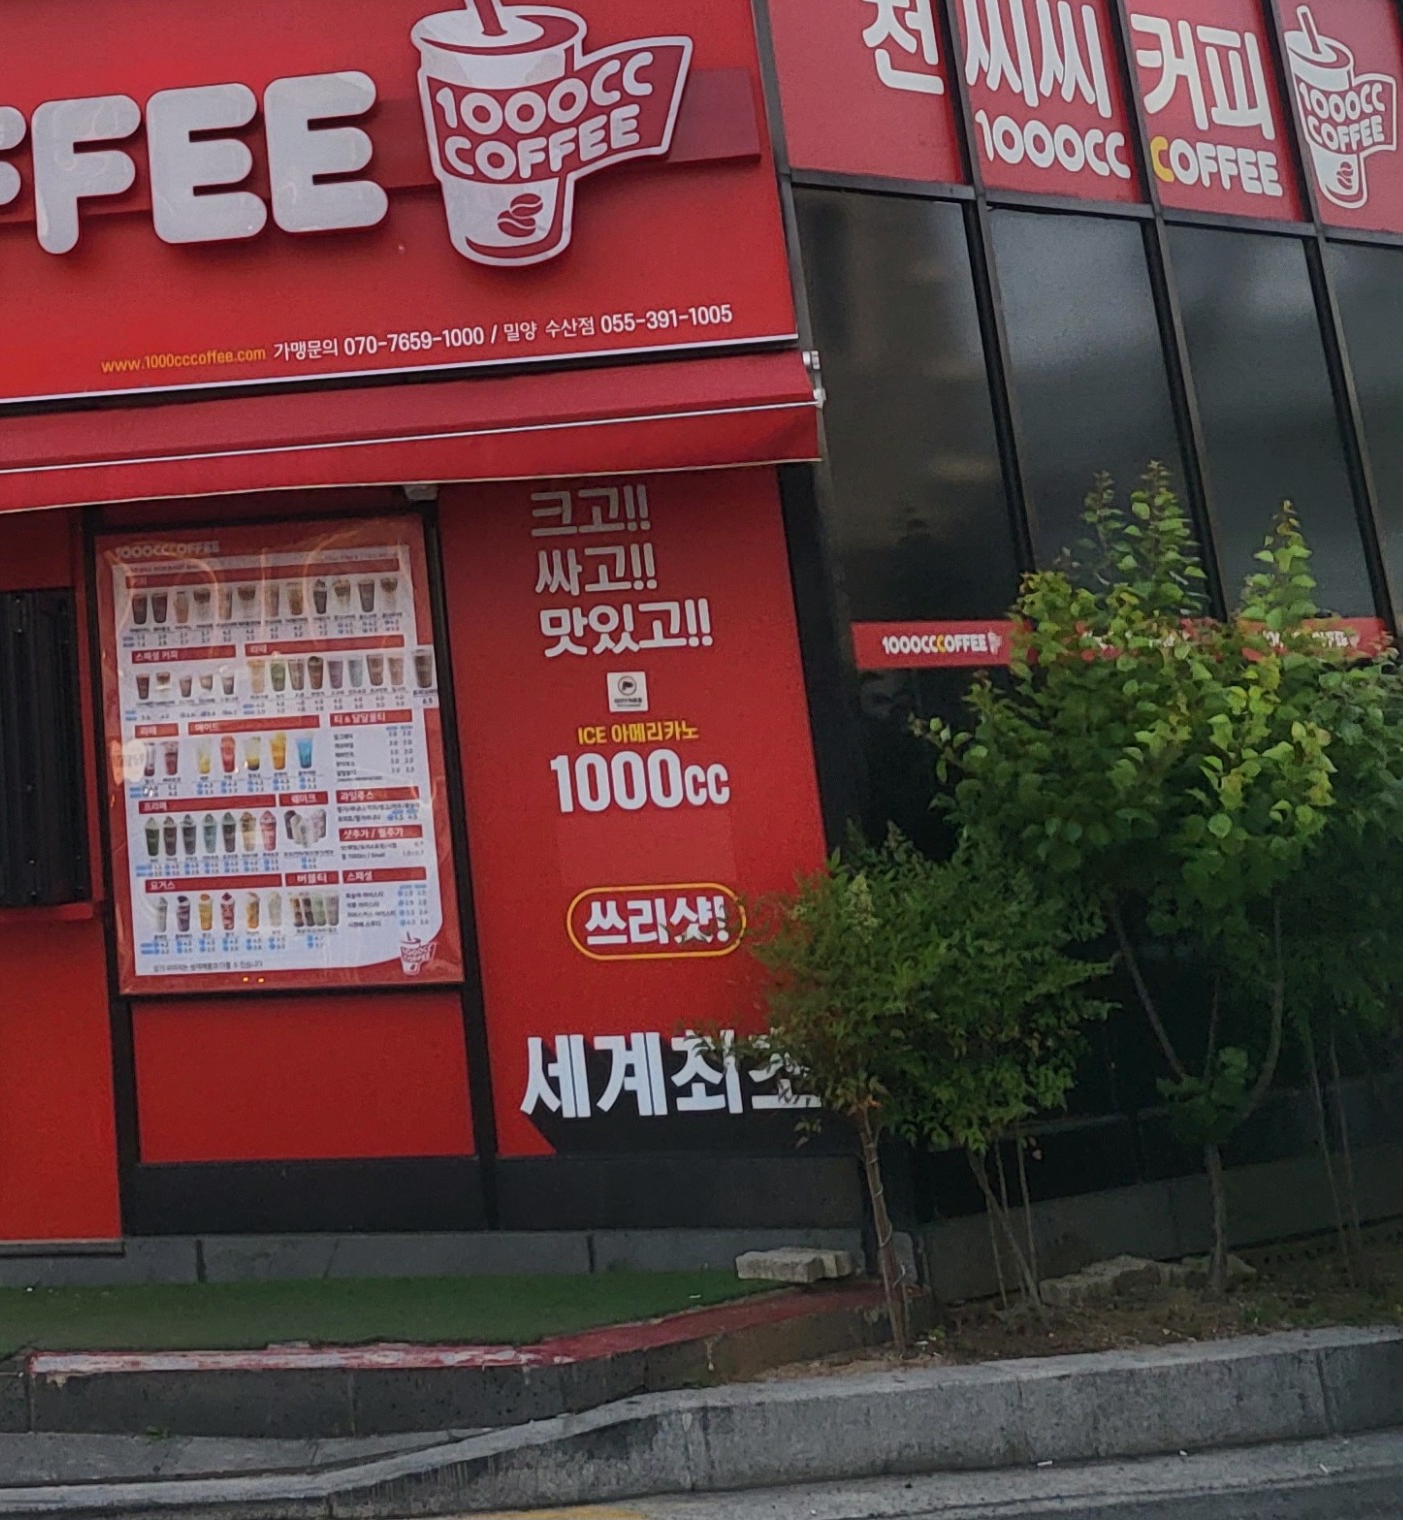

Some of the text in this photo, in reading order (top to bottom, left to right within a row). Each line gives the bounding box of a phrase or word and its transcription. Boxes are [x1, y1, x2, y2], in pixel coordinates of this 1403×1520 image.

[435, 51, 654, 137] 1000CC
[1299, 81, 1386, 124] 1000CC
[442, 104, 642, 182] COFFEE
[1307, 113, 1385, 153] COFFEE
[101, 346, 266, 374] www.1000cccoffee.com
[273, 338, 338, 362] 가맹문의
[344, 326, 484, 356] 070-7659-1000
[503, 322, 537, 343] 밀양
[545, 316, 595, 339] 수산점
[600, 304, 733, 334] 055-391-1005
[531, 484, 651, 537] 크고!!
[535, 542, 658, 597] 싸고!!
[539, 598, 714, 658] 맛있고!!
[577, 720, 699, 745] ICE 아메리카노
[550, 748, 731, 814] 1000cc
[584, 895, 730, 946] 쓰리샷!
